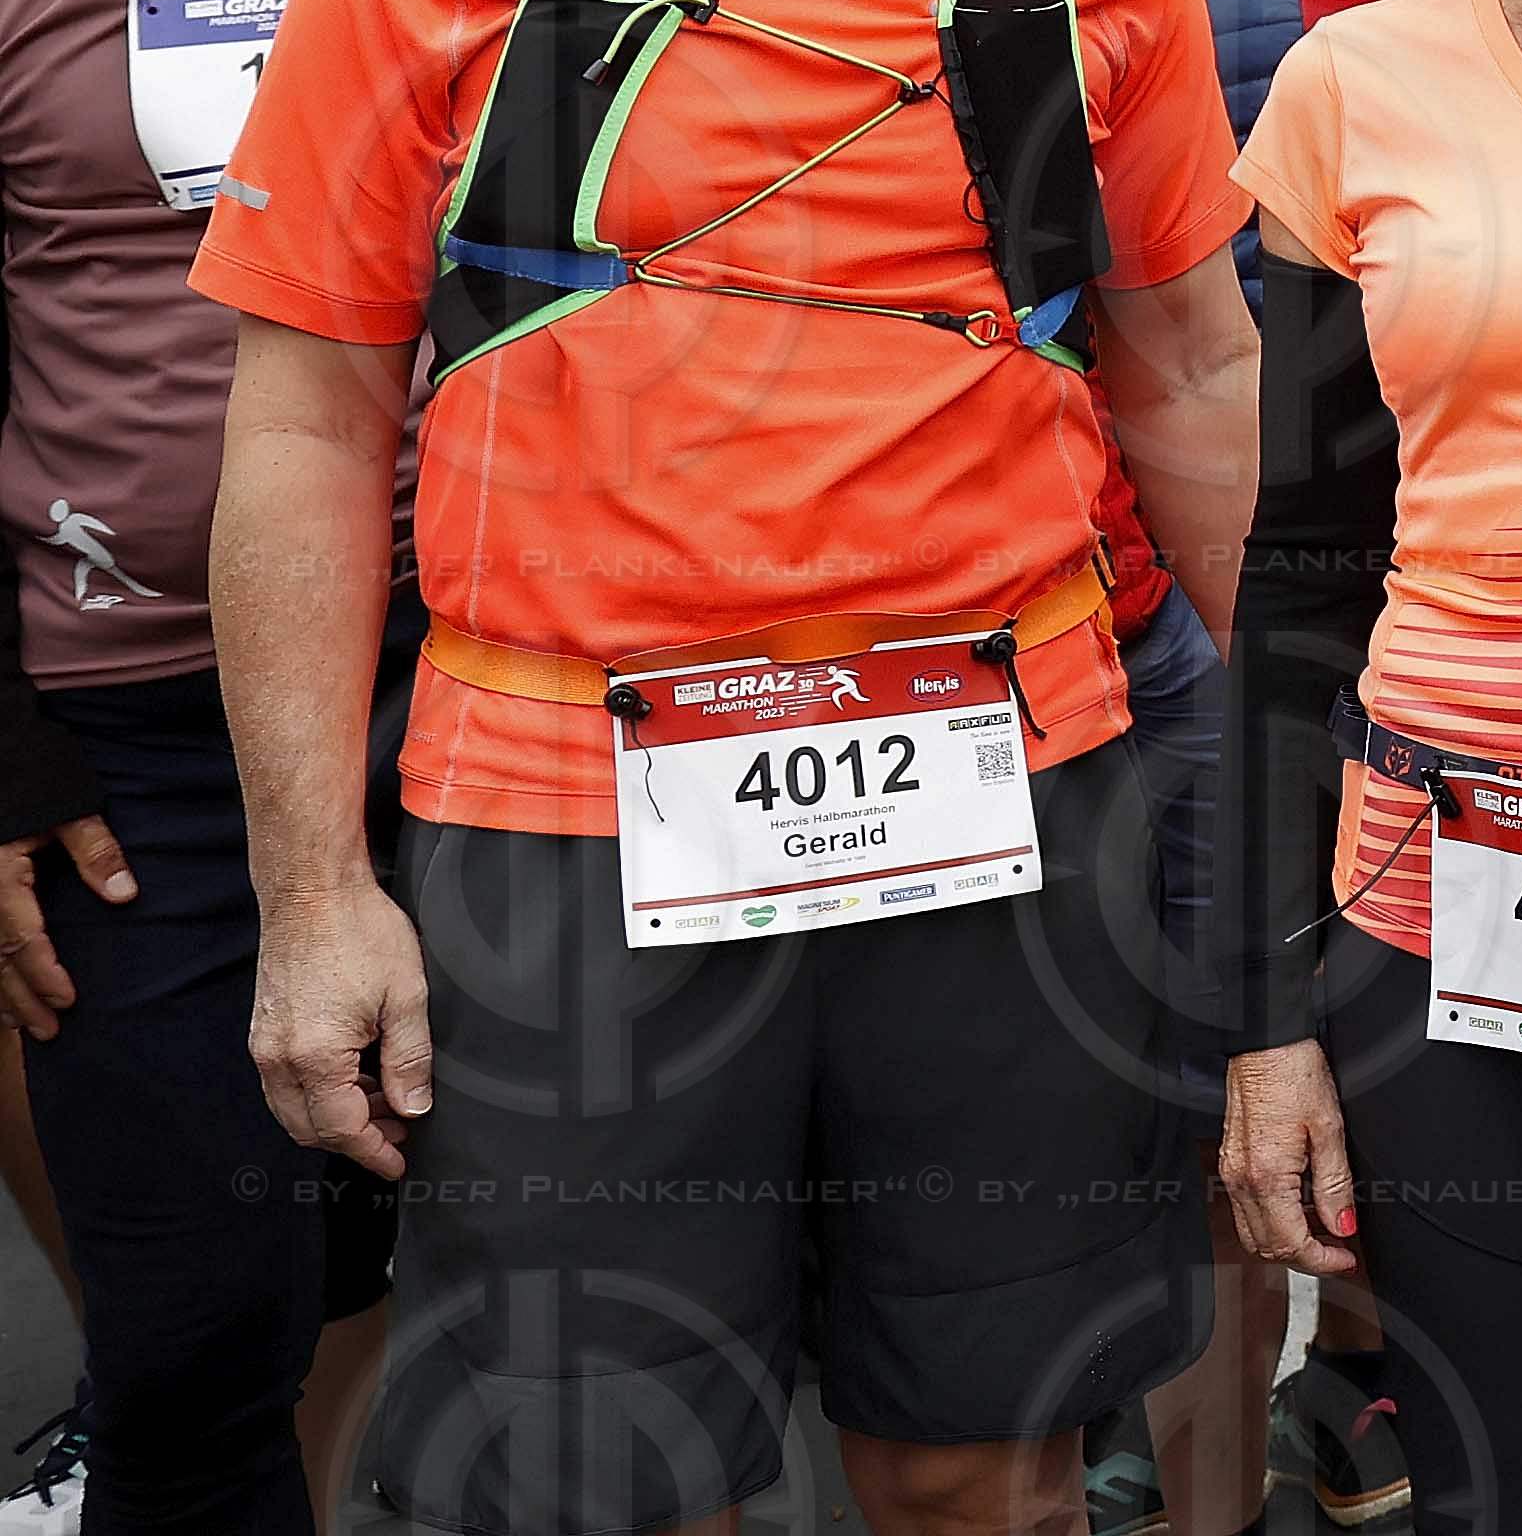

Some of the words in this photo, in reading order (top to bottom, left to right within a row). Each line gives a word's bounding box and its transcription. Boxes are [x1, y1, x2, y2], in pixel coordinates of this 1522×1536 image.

[718, 671, 796, 699] GRAZ
[913, 676, 960, 695] Hervis
[702, 696, 774, 715] MARATHON
[754, 707, 786, 720] 2023
[735, 734, 920, 812] 4012
[770, 815, 809, 830] Hervis
[813, 804, 896, 824] Halbmarathon
[783, 821, 887, 858] Gerald
